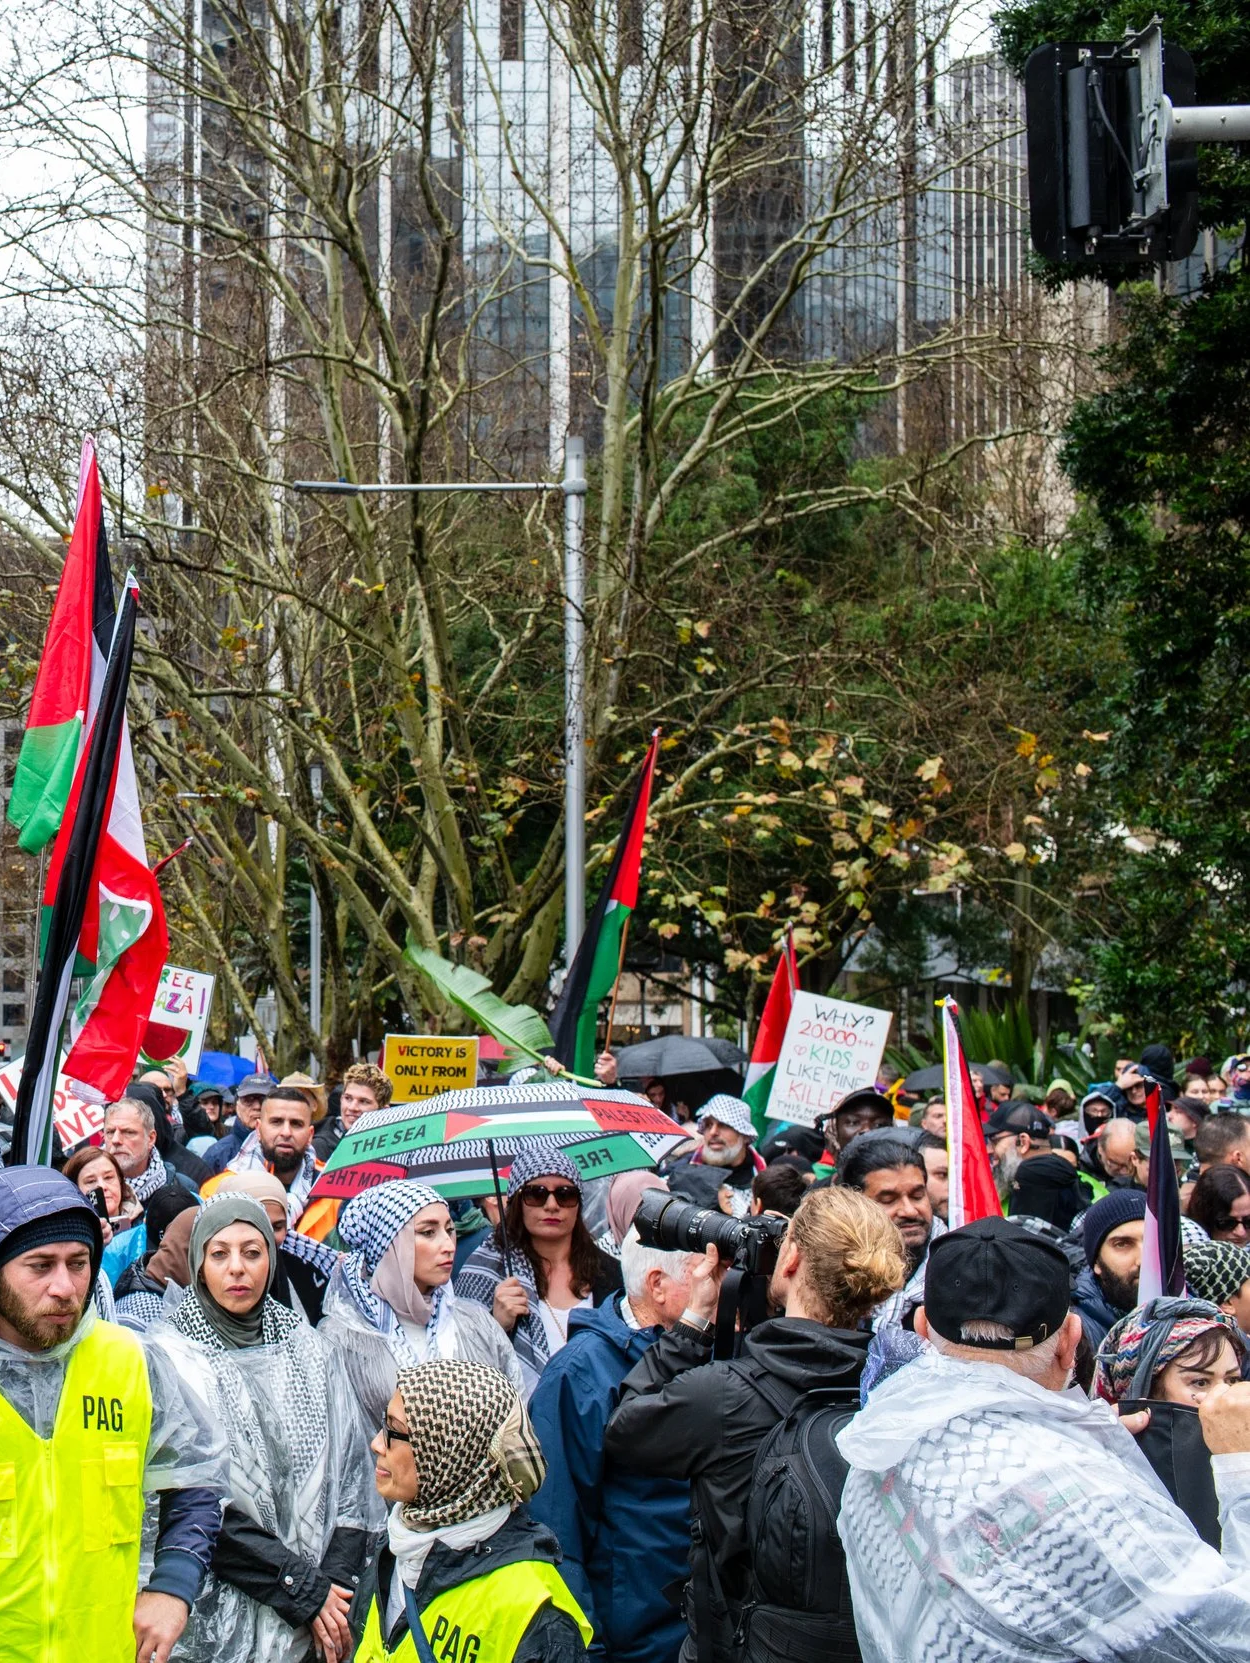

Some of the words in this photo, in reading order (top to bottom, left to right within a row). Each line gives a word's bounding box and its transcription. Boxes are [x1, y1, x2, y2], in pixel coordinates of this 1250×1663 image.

[160, 968, 195, 991] REE
[398, 1046, 453, 1058] VICTORY
[455, 1048, 467, 1058] IS
[810, 1043, 854, 1069] KIDS
[394, 1065, 429, 1076] ONLY
[432, 1066, 467, 1078] FROM
[786, 1059, 826, 1082] LIKE
[54, 1103, 105, 1149] IVE
[592, 1107, 674, 1127] PALESTINE
[352, 1134, 389, 1156] THE
[391, 1124, 427, 1145] SEA
[82, 1395, 123, 1432] PAG
[430, 1614, 481, 1663] PAG
